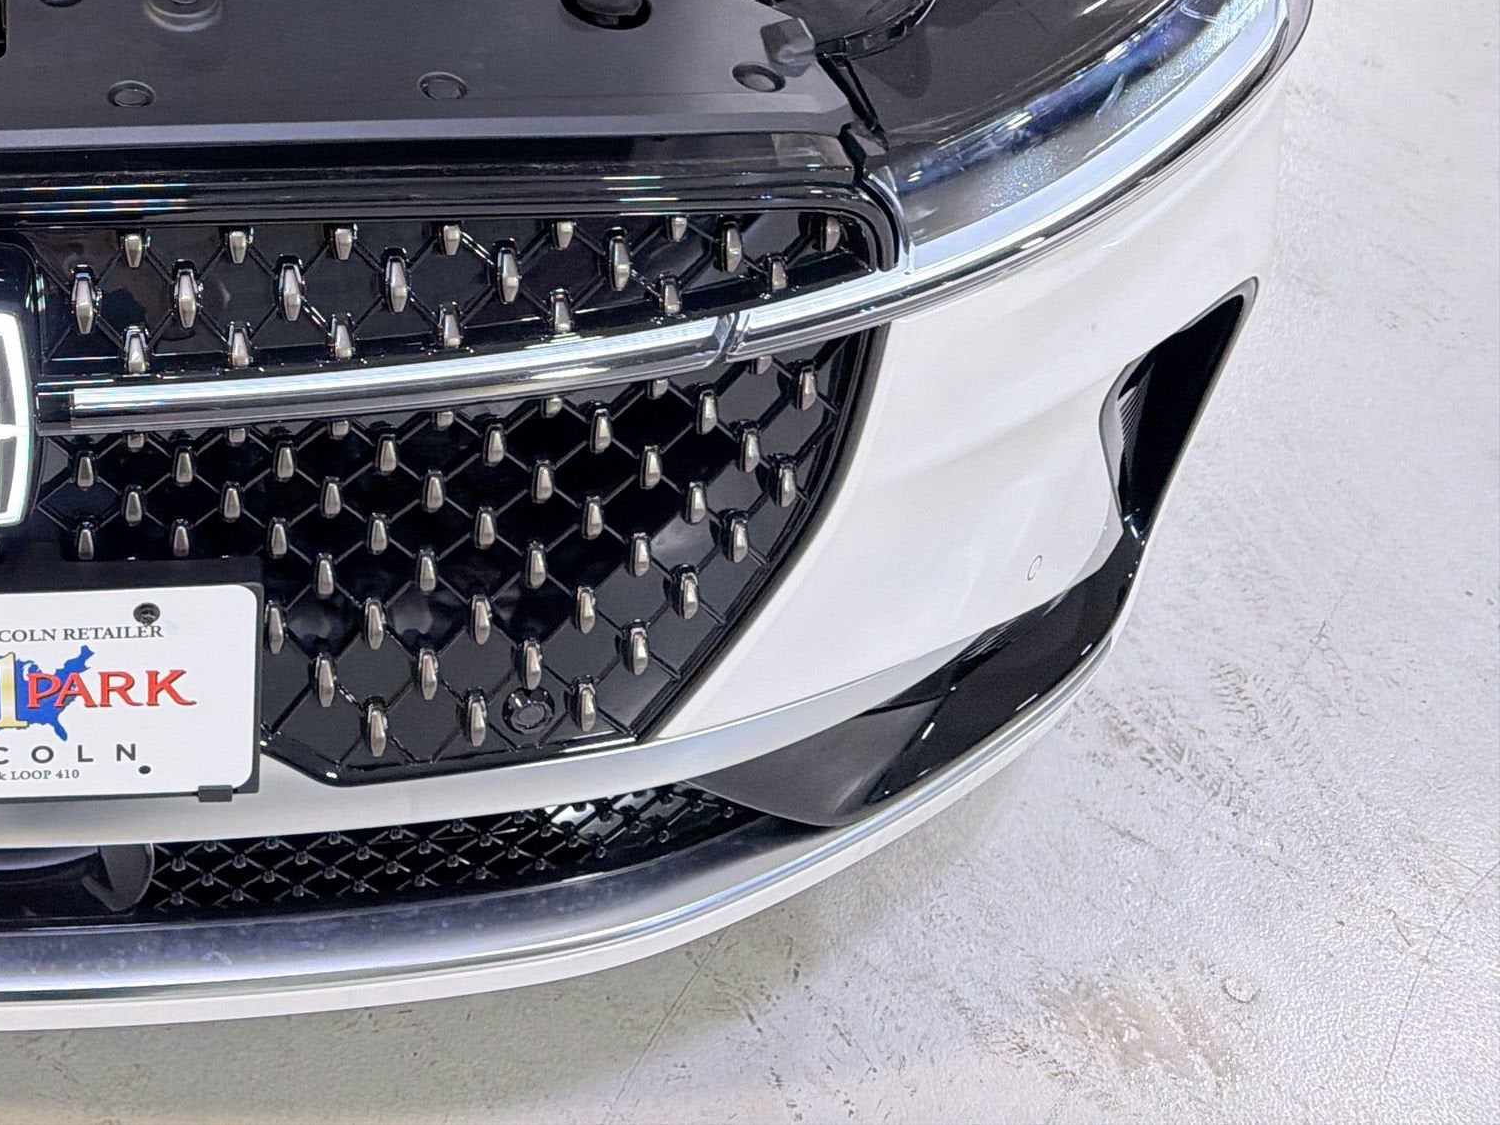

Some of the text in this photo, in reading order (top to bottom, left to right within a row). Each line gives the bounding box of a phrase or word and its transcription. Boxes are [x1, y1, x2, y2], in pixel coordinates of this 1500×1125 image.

[63, 625, 164, 641] RETAILER
[26, 670, 197, 707] PARK
[11, 770, 51, 780] LOOP
[55, 769, 80, 779] 410
